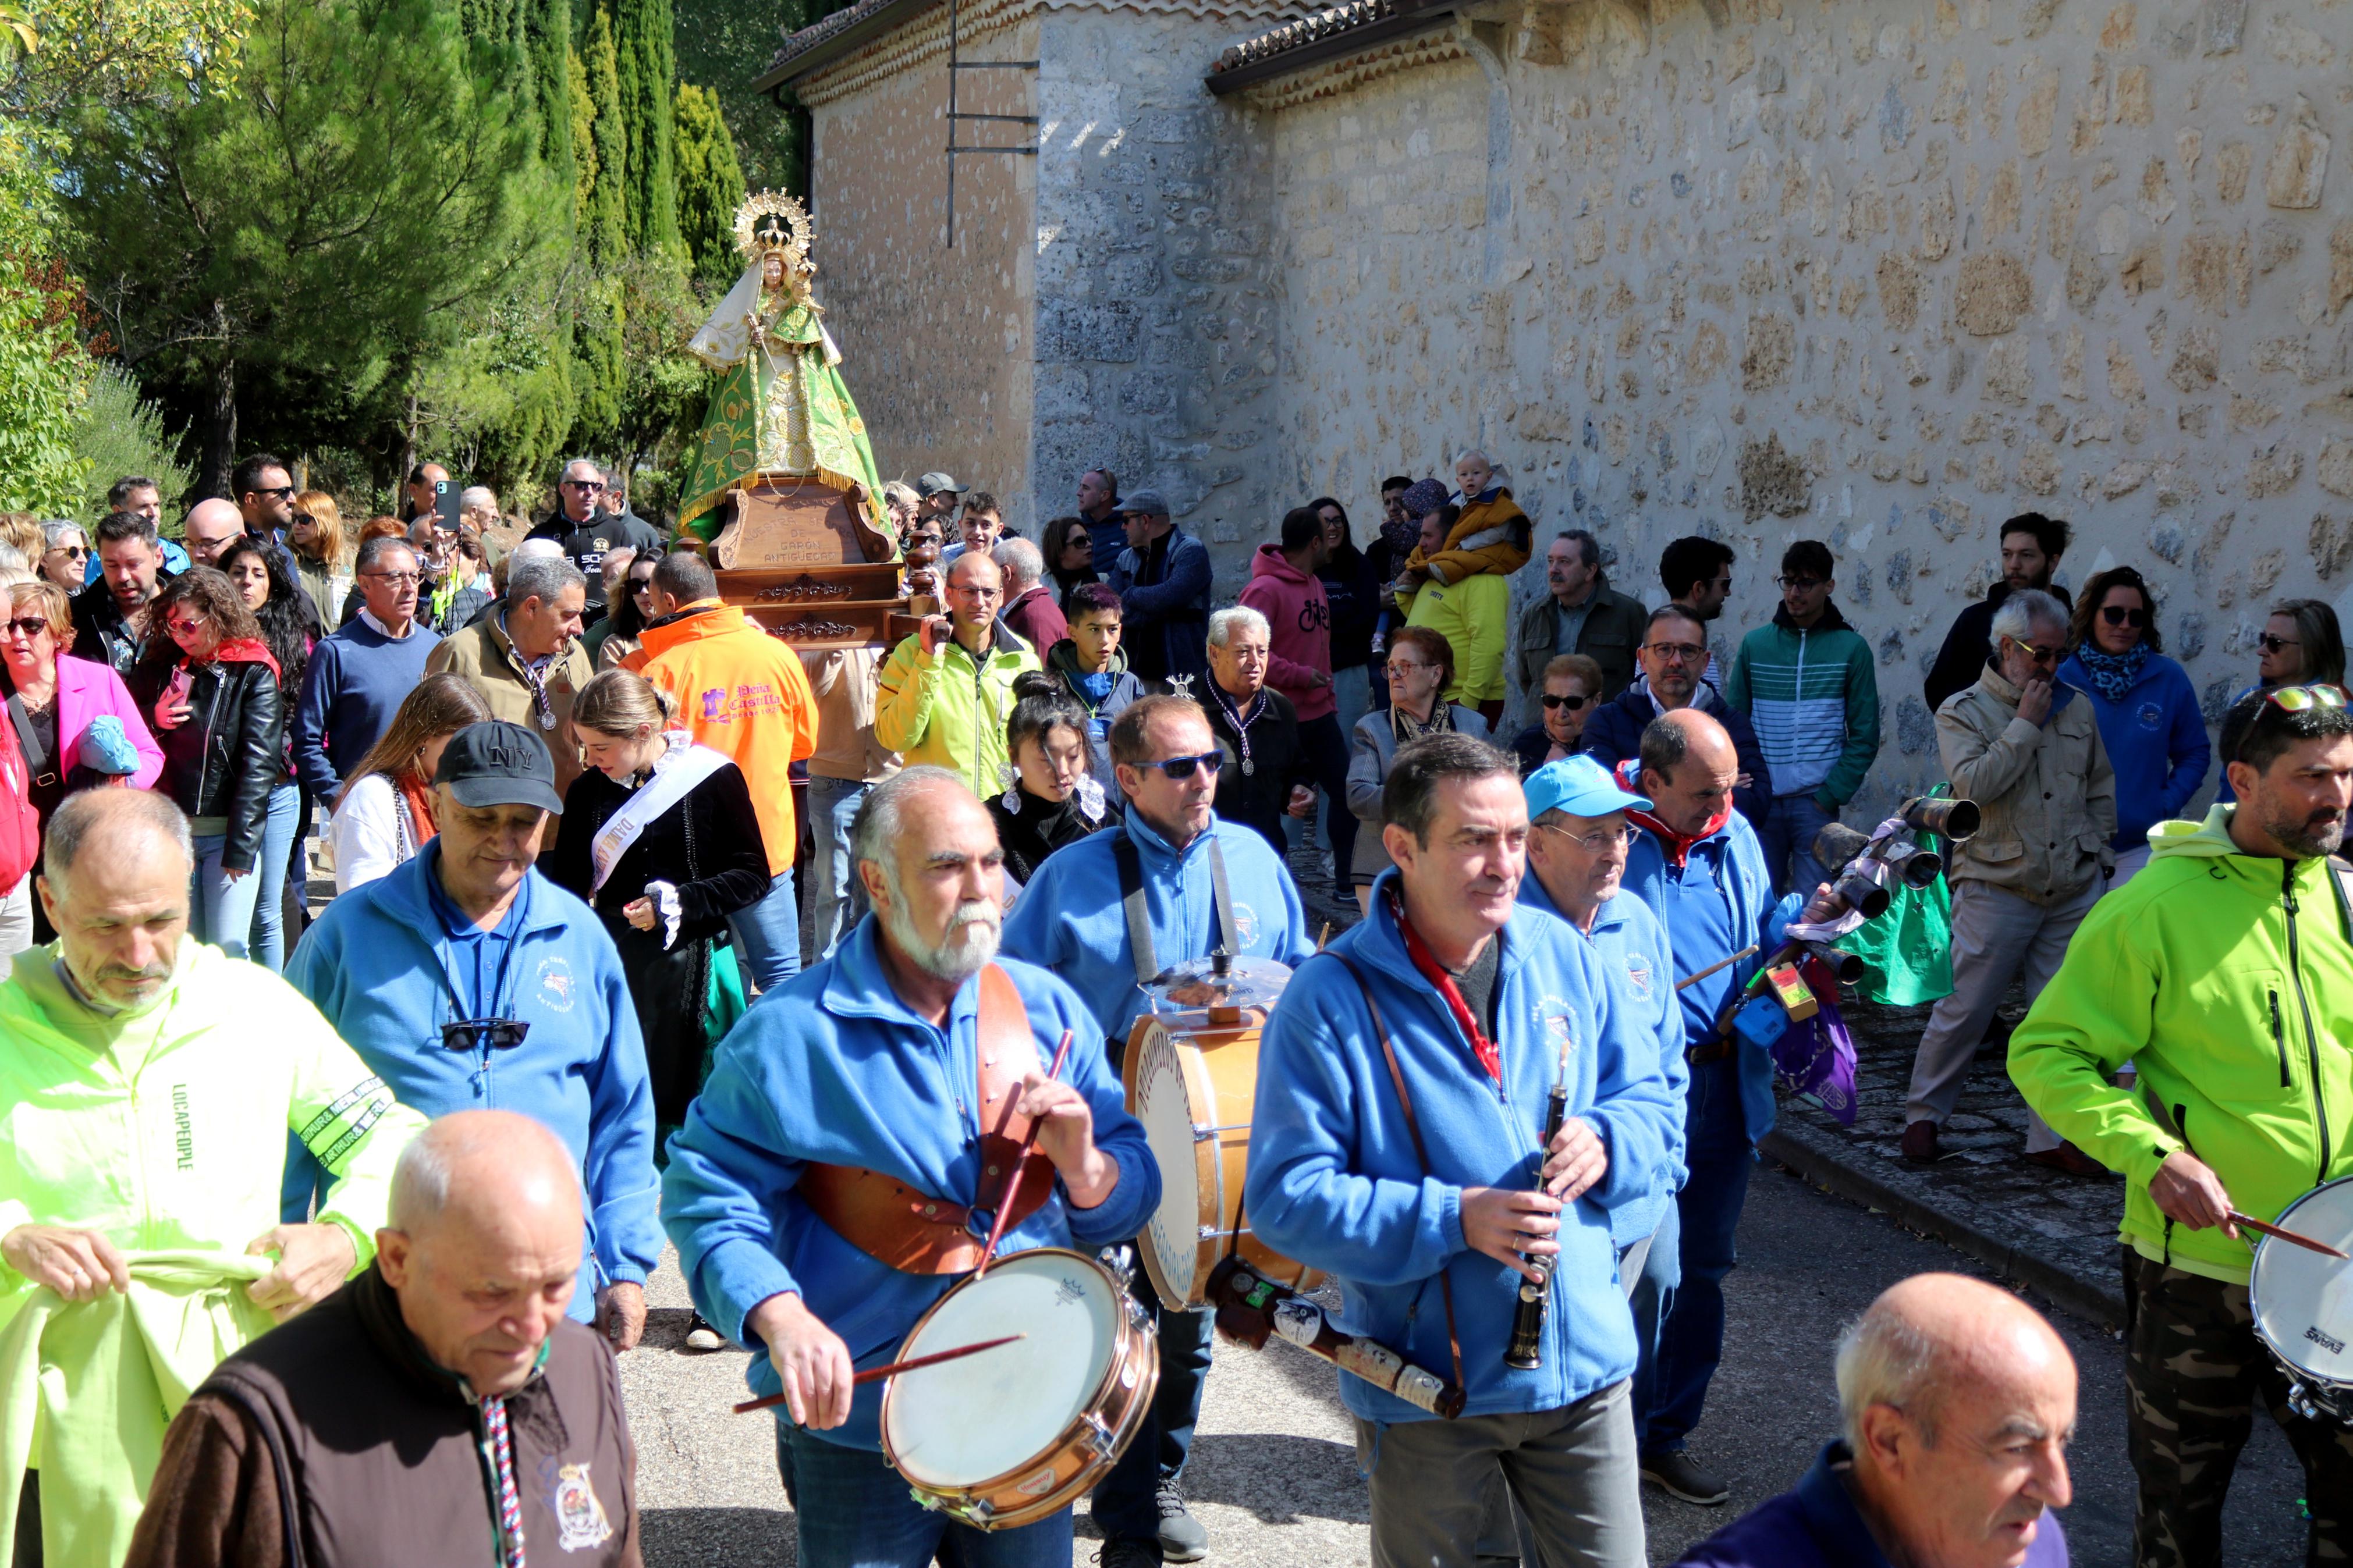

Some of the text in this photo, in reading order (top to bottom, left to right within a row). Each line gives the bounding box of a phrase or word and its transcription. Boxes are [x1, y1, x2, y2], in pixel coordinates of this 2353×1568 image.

[744, 517, 797, 545] NUESTRA
[791, 529, 806, 538] DE
[780, 538, 821, 550] GARÓN
[764, 551, 836, 563] ANTIGÜEDAD
[737, 683, 771, 698] Peña
[729, 694, 780, 710] Castilla
[601, 817, 635, 851] DAMA
[172, 1083, 193, 1172] LOCAPEOPLE
[2303, 1330, 2343, 1355] EVANS
